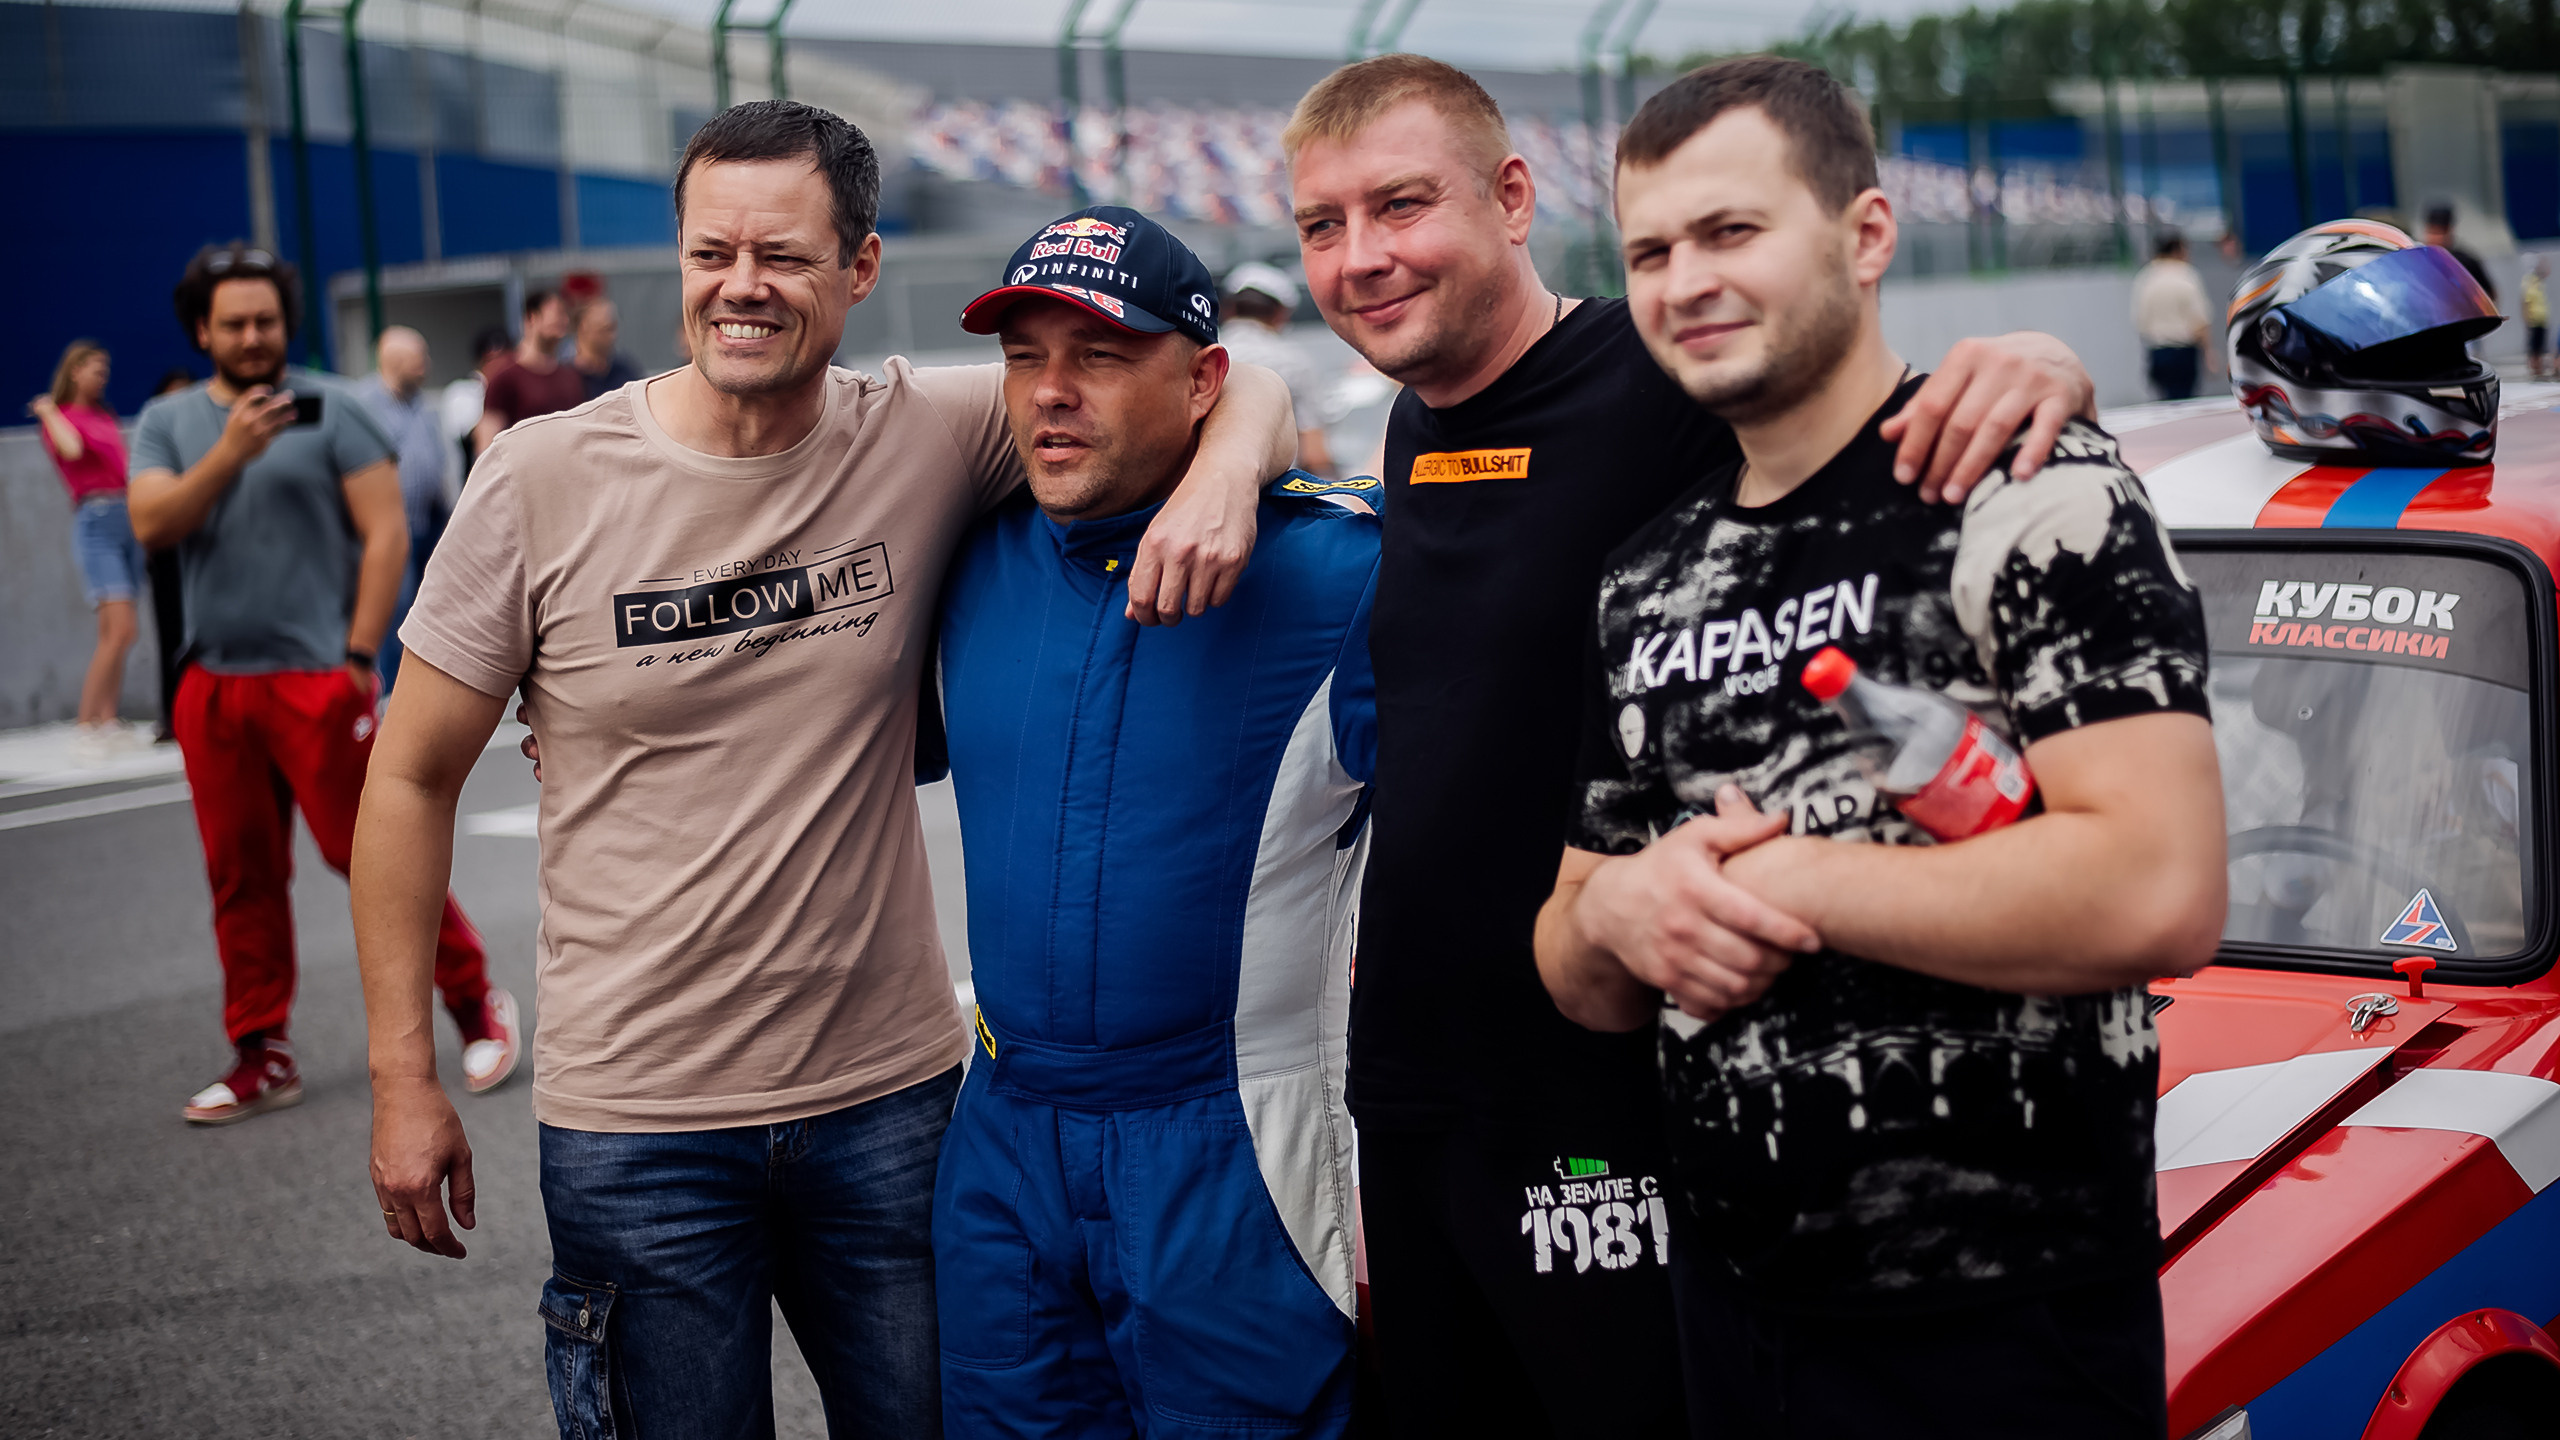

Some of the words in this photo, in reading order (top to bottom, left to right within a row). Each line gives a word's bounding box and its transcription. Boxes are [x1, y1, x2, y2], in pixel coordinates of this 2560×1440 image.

[1030, 237, 1074, 260] Red
[1073, 238, 1121, 265] Bull
[1041, 262, 1138, 289] INFINITI
[1460, 455, 1526, 475] BULLSHIT
[694, 559, 760, 583] EVERY
[764, 549, 802, 570] DAY
[624, 579, 799, 635] FOLLOW
[816, 558, 878, 602] ME
[2255, 580, 2462, 631] КУБОК
[636, 654, 661, 668] a
[667, 644, 726, 664] new
[734, 611, 880, 658] beginning
[1626, 573, 1880, 693] KAPASEN
[2249, 622, 2450, 660] КЛАССИКИ
[1525, 1185, 1556, 1208] НА
[1559, 1177, 1635, 1205] ЗЕМЛЕ
[1639, 1176, 1659, 1196] С
[1521, 1197, 1669, 1274] 1981
